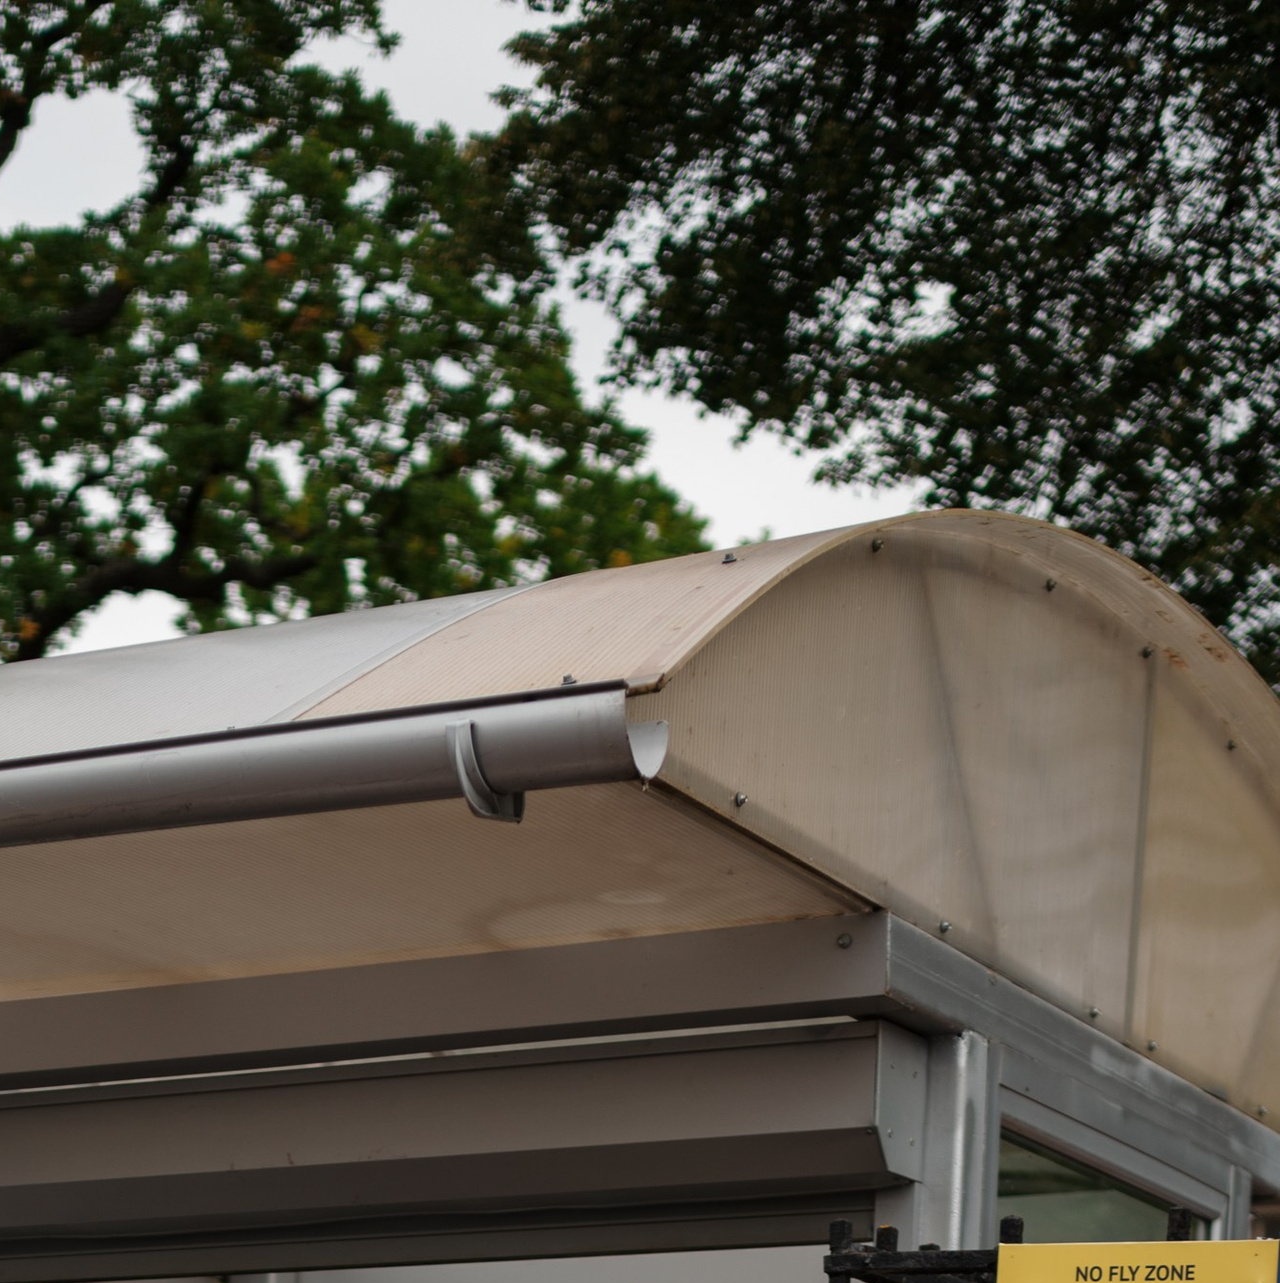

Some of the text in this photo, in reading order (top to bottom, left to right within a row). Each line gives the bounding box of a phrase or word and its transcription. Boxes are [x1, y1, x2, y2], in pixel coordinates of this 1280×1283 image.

[1075, 1264, 1196, 1282] NO FLY ZONE
